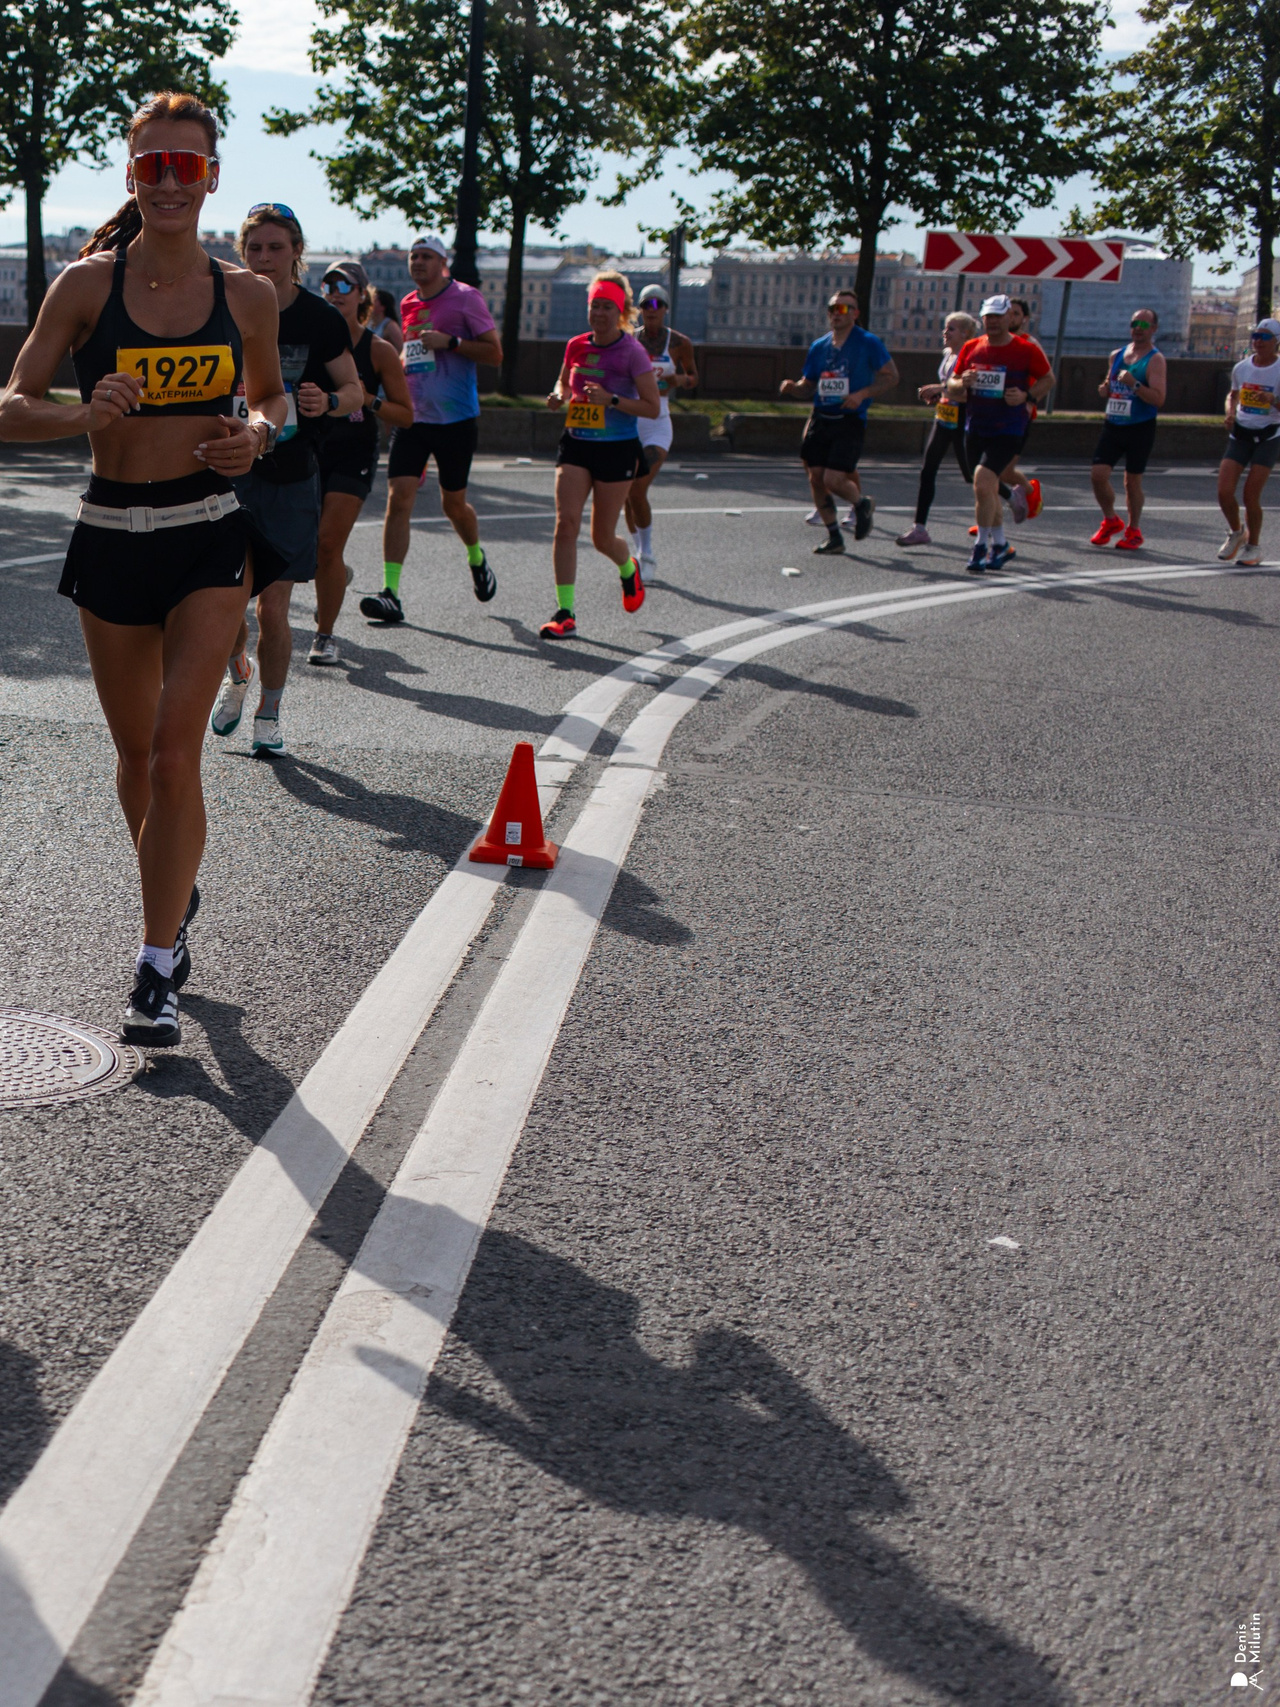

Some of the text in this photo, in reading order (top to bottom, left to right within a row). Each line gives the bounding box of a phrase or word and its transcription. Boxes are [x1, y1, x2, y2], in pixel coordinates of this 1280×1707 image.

[135, 355, 220, 389] 1927
[147, 389, 203, 401] КАТЕРИНА
[571, 406, 599, 421] 2216
